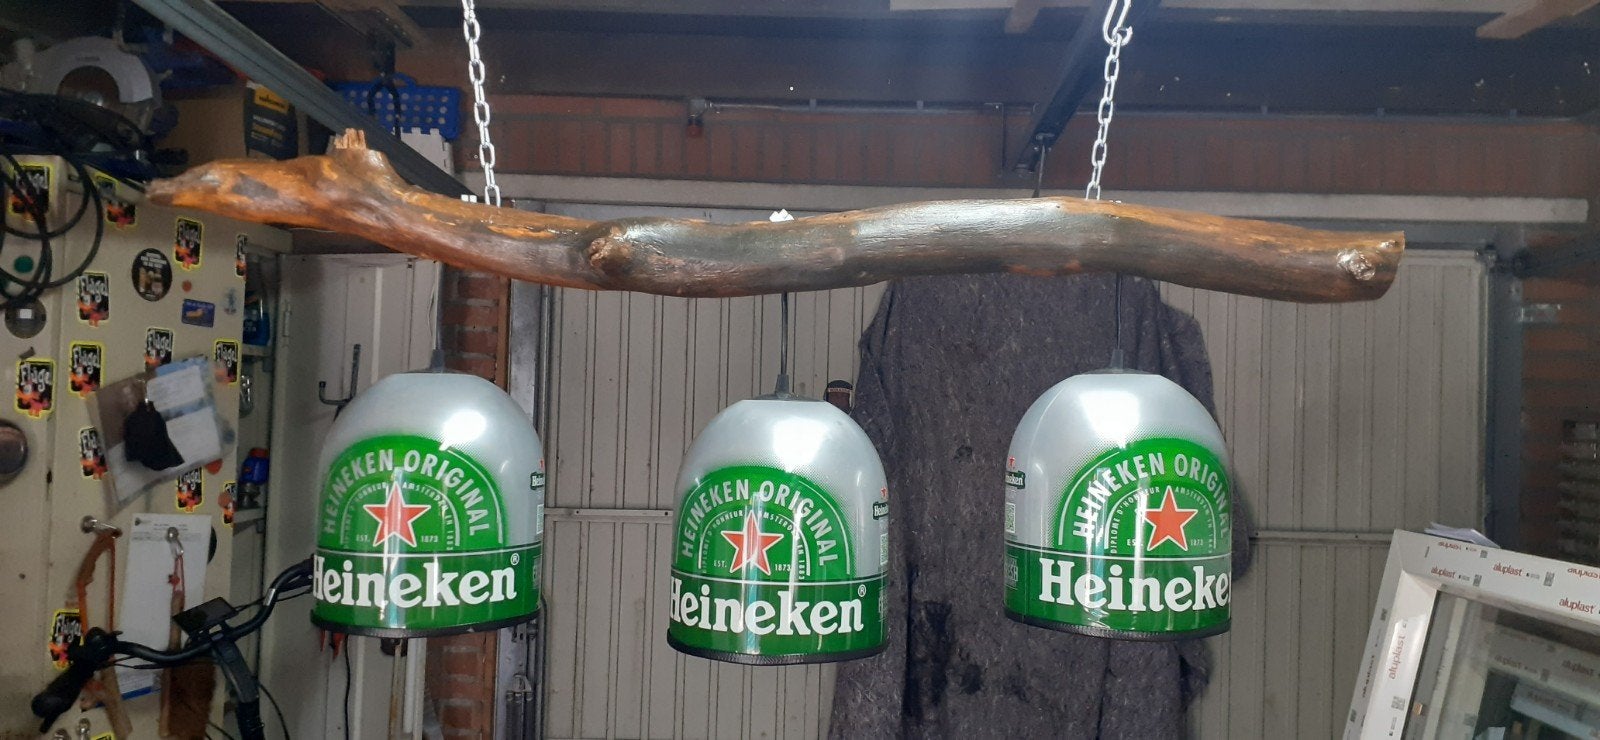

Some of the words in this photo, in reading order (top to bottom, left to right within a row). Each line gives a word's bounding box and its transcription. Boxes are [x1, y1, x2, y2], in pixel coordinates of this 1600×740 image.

[324, 449, 394, 534] HEINEKEN
[404, 450, 490, 536] ORIGINAL
[1073, 453, 1165, 538] HEINEKEN
[1174, 453, 1231, 539] ORIGINAL
[682, 479, 750, 558] HEINEKEN
[758, 480, 839, 566] ORIGINAL
[313, 554, 518, 608] Heineken
[1039, 557, 1231, 612] Heineke
[1493, 562, 1523, 577] aluplast
[670, 577, 865, 636] Heineken
[1559, 597, 1595, 614] aluplast
[1388, 635, 1405, 680] aluplast
